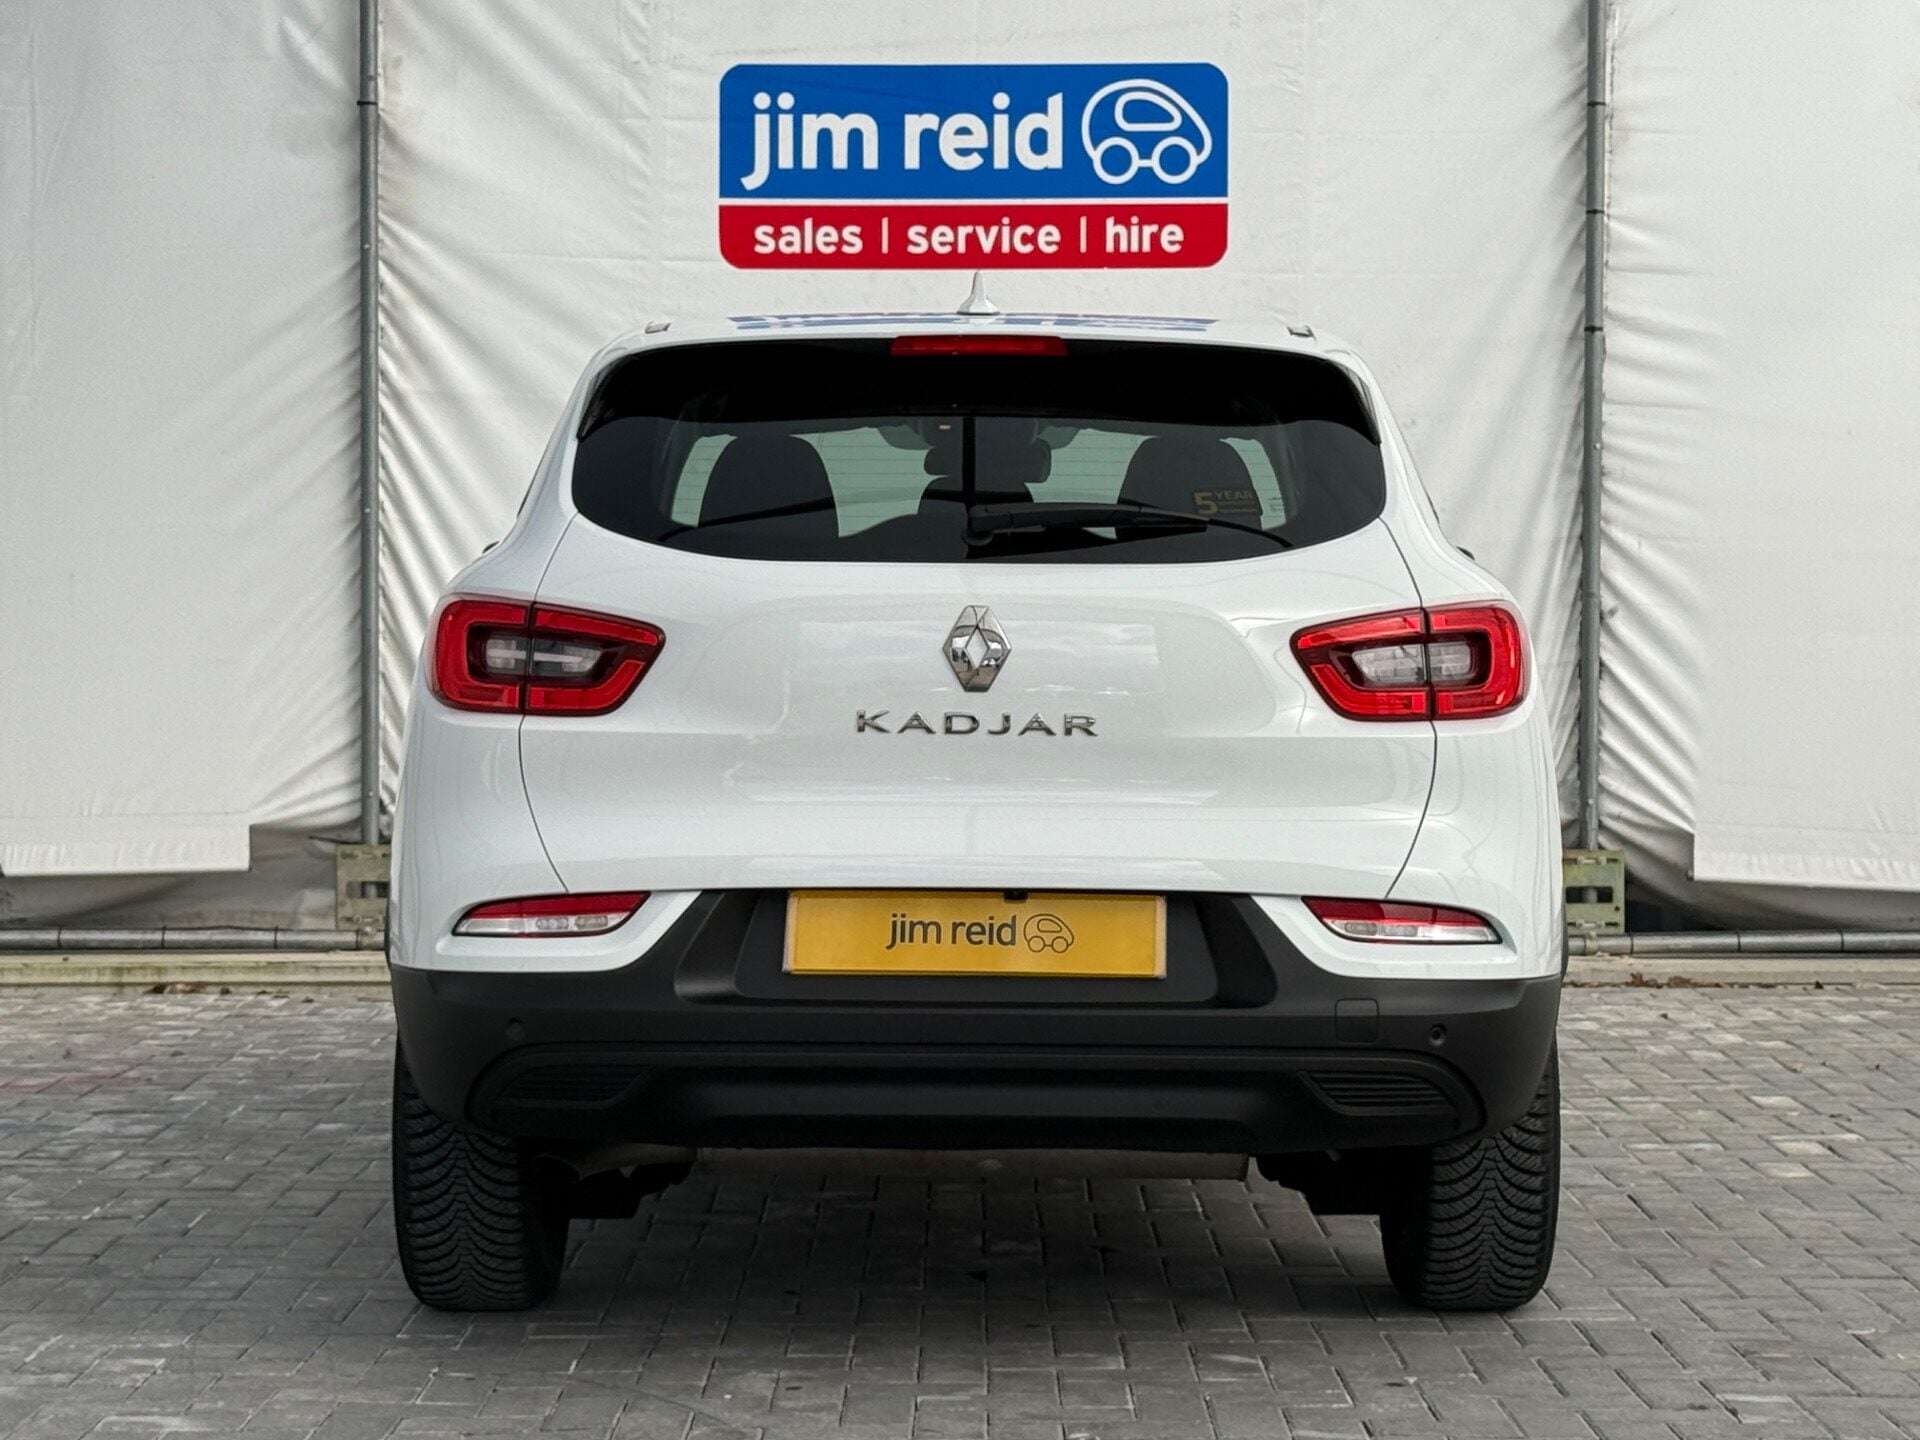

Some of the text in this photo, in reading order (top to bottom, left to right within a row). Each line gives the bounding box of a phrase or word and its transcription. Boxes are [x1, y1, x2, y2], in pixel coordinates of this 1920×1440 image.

[740, 92, 1064, 191] jim reid
[754, 216, 1185, 255] sales service hire
[1194, 491, 1218, 514] 5
[856, 709, 1099, 737] KADJAR
[886, 913, 1017, 950] jim reid
